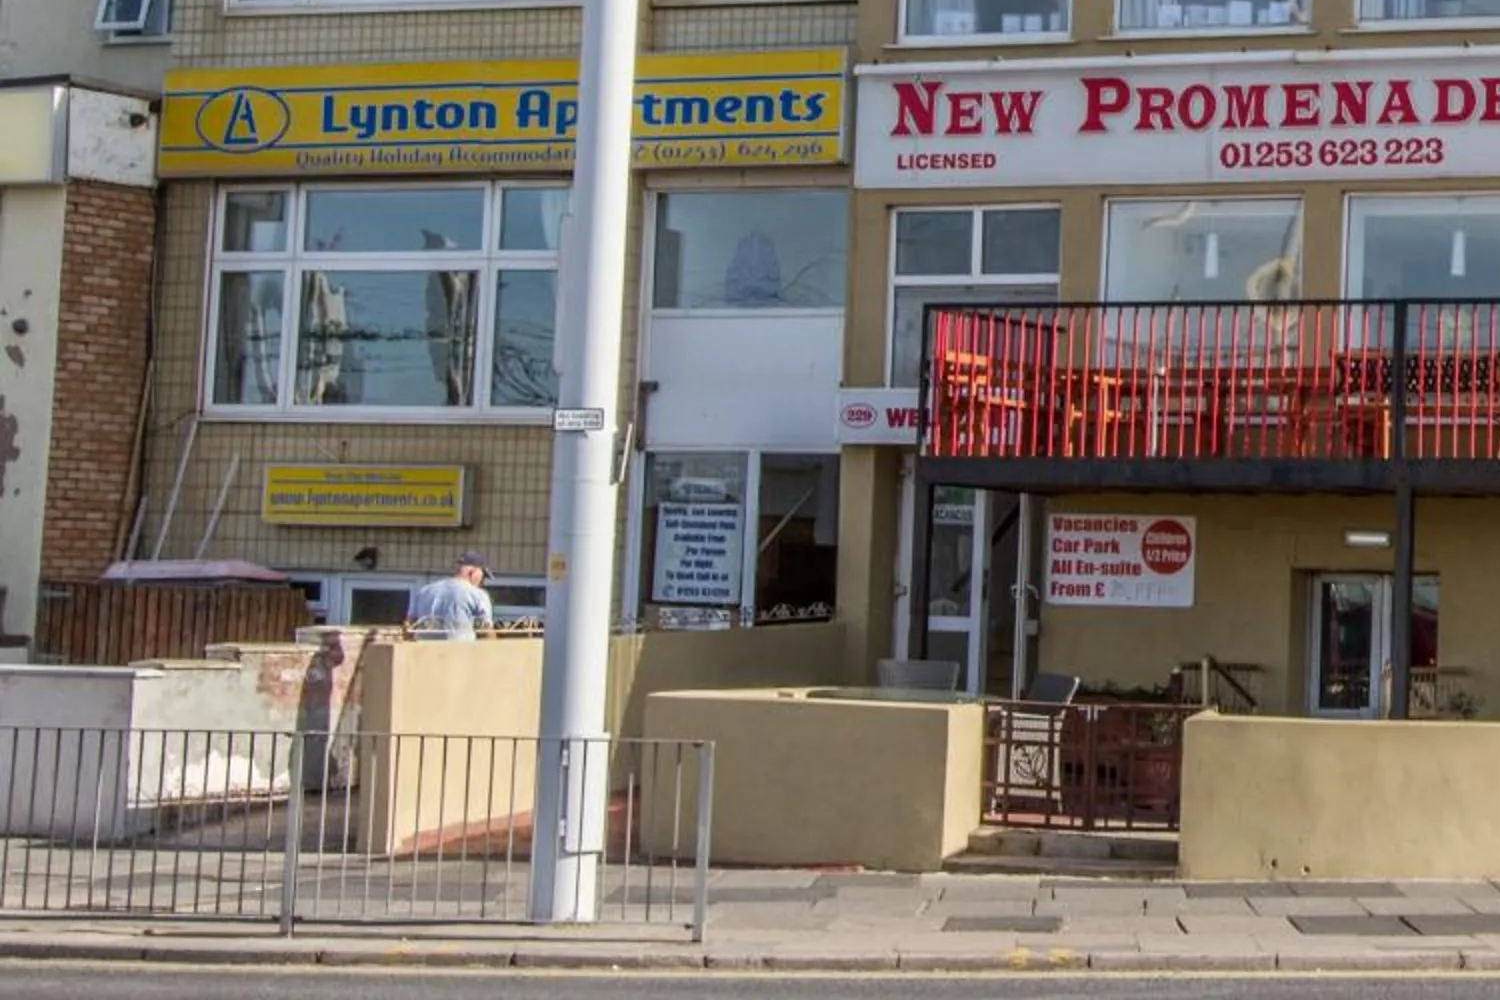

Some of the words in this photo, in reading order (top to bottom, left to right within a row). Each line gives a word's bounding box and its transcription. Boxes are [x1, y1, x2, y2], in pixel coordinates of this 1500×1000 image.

[322, 95, 496, 138] Lynton
[516, 88, 826, 135] Aptments
[891, 80, 1043, 137] NEW
[897, 152, 997, 171] LICENSED
[1220, 141, 1313, 169] 01253
[1318, 140, 1379, 167] 623
[1384, 138, 1444, 164] 223
[1052, 517, 1139, 532] Vacancies
[1052, 538, 1081, 553] Car
[1084, 538, 1120, 554] Park
[1051, 560, 1073, 575] All
[1076, 559, 1142, 576] En-suite
[1051, 581, 1090, 597] From
